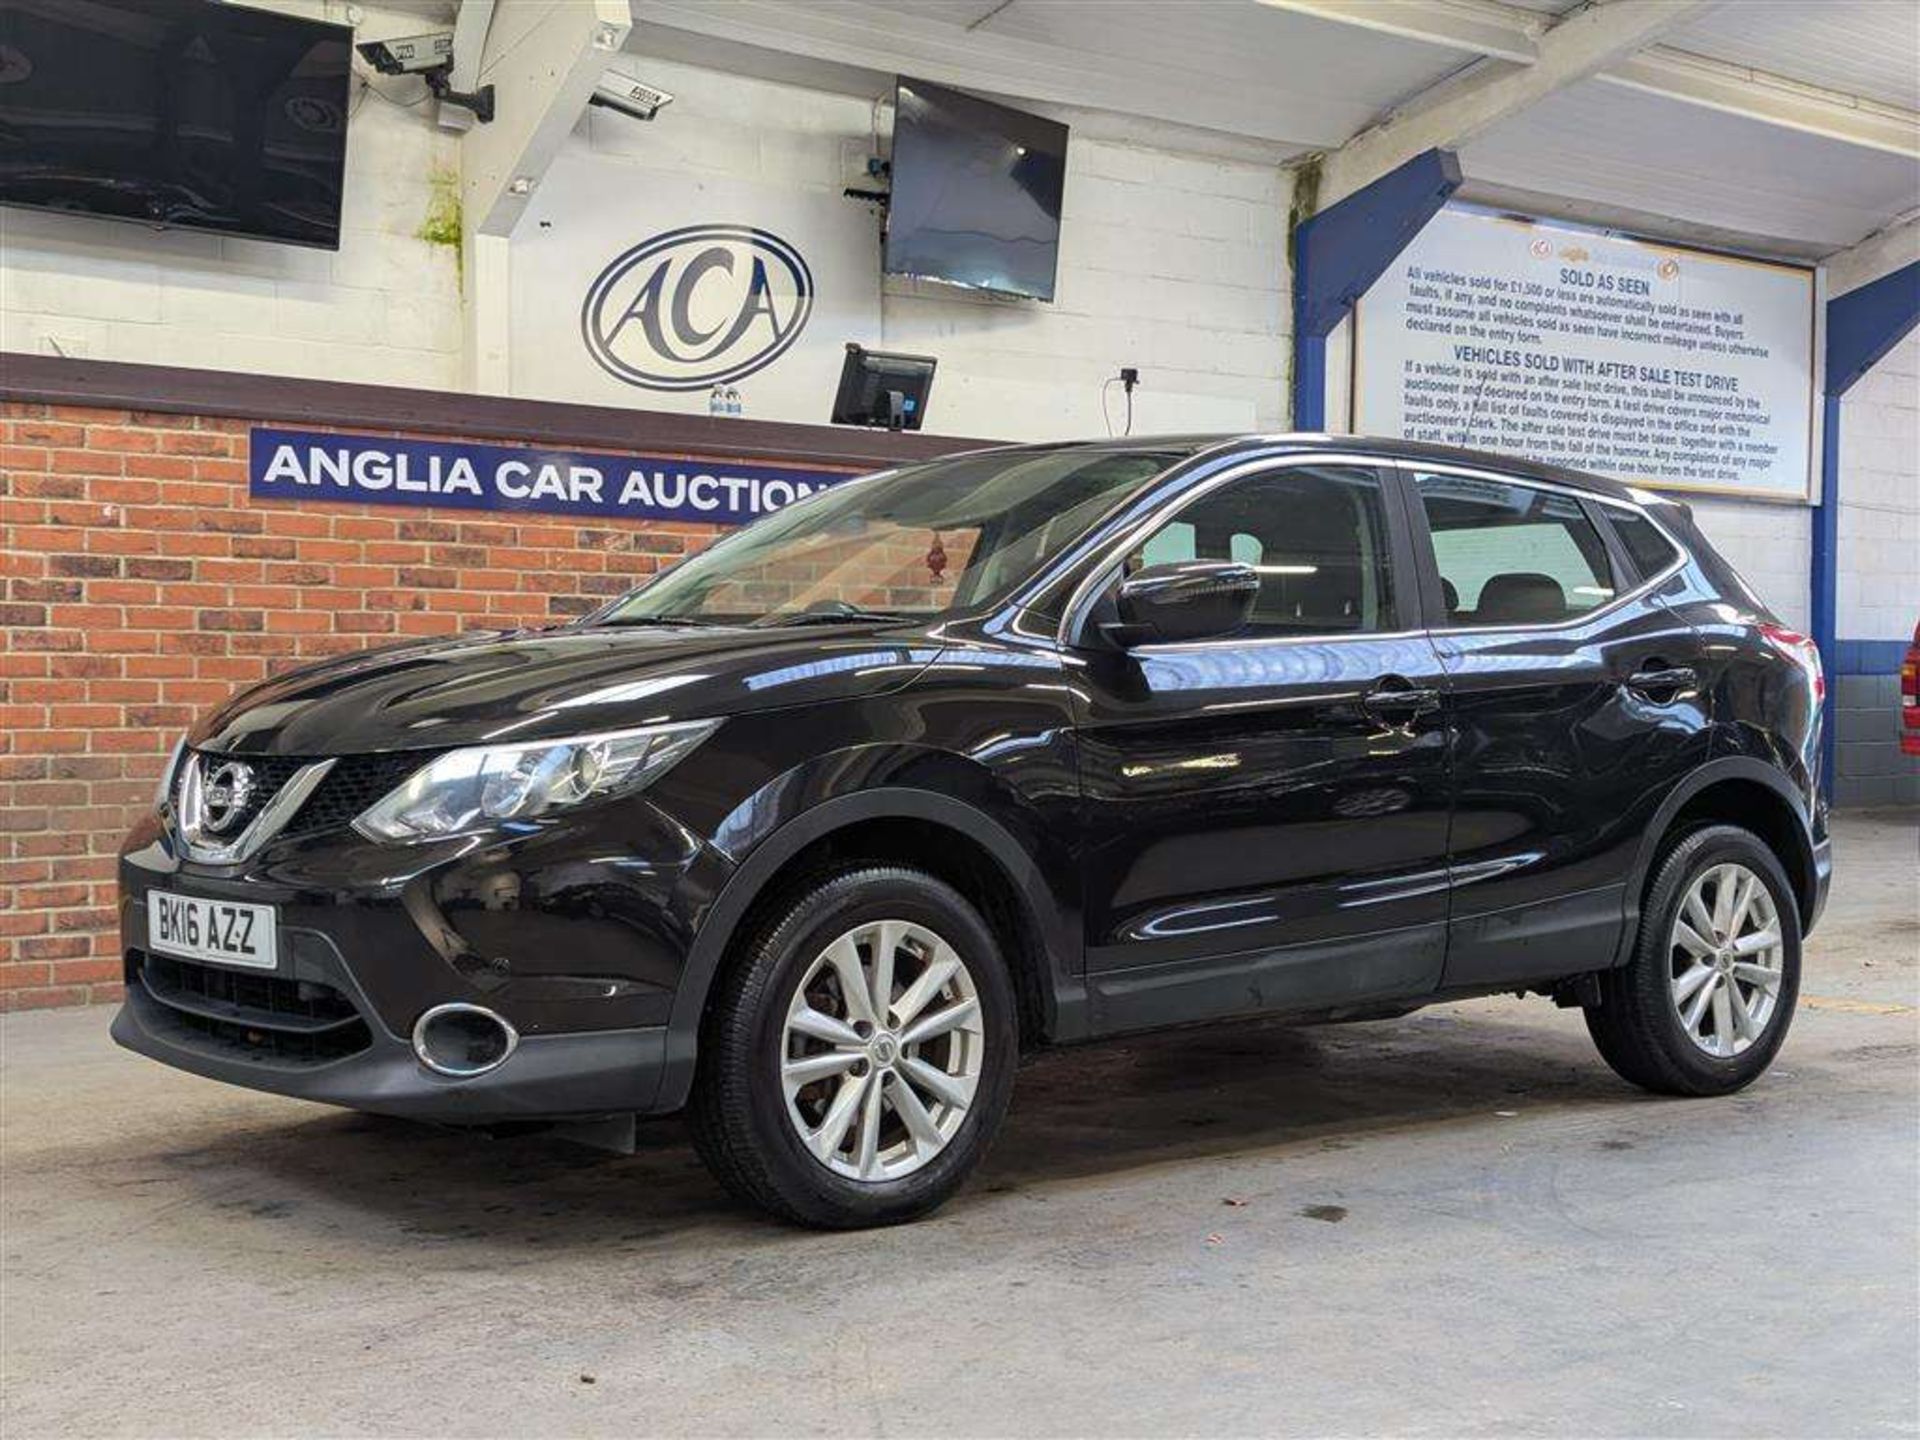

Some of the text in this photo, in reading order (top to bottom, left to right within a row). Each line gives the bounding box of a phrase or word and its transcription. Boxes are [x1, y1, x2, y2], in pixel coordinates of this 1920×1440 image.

[603, 247, 782, 363] ACA
[1407, 266, 1421, 280] All
[1422, 268, 1466, 286] vehicles
[1468, 275, 1491, 290] sold
[1493, 278, 1507, 292] for
[1557, 287, 1576, 301] less
[1578, 293, 1593, 304] are
[1595, 293, 1655, 315] automatically
[1658, 302, 1676, 315] sold
[1691, 309, 1711, 320] seen
[1713, 310, 1731, 323] with
[1559, 268, 1649, 295] SOLD AS SEEN
[1405, 300, 1432, 315] must
[1435, 306, 1475, 320] assume
[1477, 309, 1490, 322] all
[1492, 311, 1534, 328] vehicles
[1535, 316, 1556, 330] sold
[1572, 324, 1594, 335] seen
[1596, 324, 1618, 338] have
[1620, 328, 1661, 344] incorrect
[1662, 333, 1696, 351] mileage
[1698, 338, 1726, 352] unless
[1728, 342, 1768, 357] otherwise
[1406, 316, 1451, 333] declared
[1469, 323, 1485, 337] the
[1488, 326, 1513, 343] entry
[1516, 329, 1541, 344] form.
[1477, 290, 1496, 305] and
[1514, 295, 1567, 317] complaints
[1569, 303, 1622, 322] whatsoever
[1625, 311, 1646, 325] shall
[1714, 323, 1743, 340] Buyers
[1423, 362, 1460, 377] vehicle
[1475, 367, 1497, 381] sold
[1500, 370, 1521, 384] with
[1523, 375, 1536, 385] an
[1538, 374, 1558, 388] after
[1562, 377, 1581, 390] sale
[1583, 379, 1601, 392] test
[1630, 385, 1648, 397] this
[1650, 387, 1671, 399] shall
[1687, 391, 1732, 406] announced
[1747, 398, 1760, 409] the
[1454, 344, 1738, 391] VEHICLES SOLD WITH AFTER SALE TEST DRIVE
[1404, 377, 1459, 393] auctioneer
[1462, 383, 1481, 396] and
[1484, 385, 1527, 400] declared
[1543, 391, 1558, 403] the
[1561, 393, 1585, 408] entry
[1587, 396, 1611, 408] form.
[1622, 399, 1640, 411] test
[1642, 401, 1664, 414] drive
[1666, 406, 1696, 417] covers
[1698, 407, 1723, 422] major
[1724, 410, 1770, 424] mechanical
[1404, 392, 1432, 407] faults
[1491, 401, 1506, 414] list
[1521, 404, 1548, 418] faults
[1550, 407, 1588, 422] covered
[1600, 412, 1645, 429] displayed
[1657, 417, 1671, 429] the
[1673, 419, 1698, 432] office
[1700, 422, 1716, 434] and
[1717, 423, 1735, 435] with
[1737, 425, 1750, 437] the
[1403, 410, 1466, 427] auctioneer's
[1469, 416, 1497, 430] clerk.
[1500, 419, 1519, 432] The
[1521, 421, 1543, 434] after
[1545, 423, 1565, 436] sale
[1567, 425, 1585, 437] test
[1587, 427, 1611, 440] drive
[1612, 429, 1635, 442] must
[1680, 436, 1716, 451] together
[1719, 439, 1736, 450] with
[1744, 442, 1777, 454] member
[1446, 430, 1477, 444] within
[1479, 436, 1499, 446] one
[1501, 435, 1523, 448] hour
[1526, 437, 1549, 450] from
[1551, 439, 1565, 451] the
[1568, 441, 1583, 452] fall
[1595, 443, 1611, 455] the
[1653, 448, 1670, 462] Any
[1672, 450, 1719, 466] complaints
[1732, 457, 1746, 468] any
[1747, 456, 1772, 470] major
[263, 445, 483, 496] ANGLIA
[495, 461, 603, 503] CAR
[1589, 458, 1616, 471] within
[1618, 463, 1635, 472] one
[1637, 462, 1657, 474] hour
[1659, 463, 1681, 475] from
[1683, 465, 1697, 477] the
[1698, 467, 1715, 478] test
[159, 897, 256, 954] BK16 AZZ
